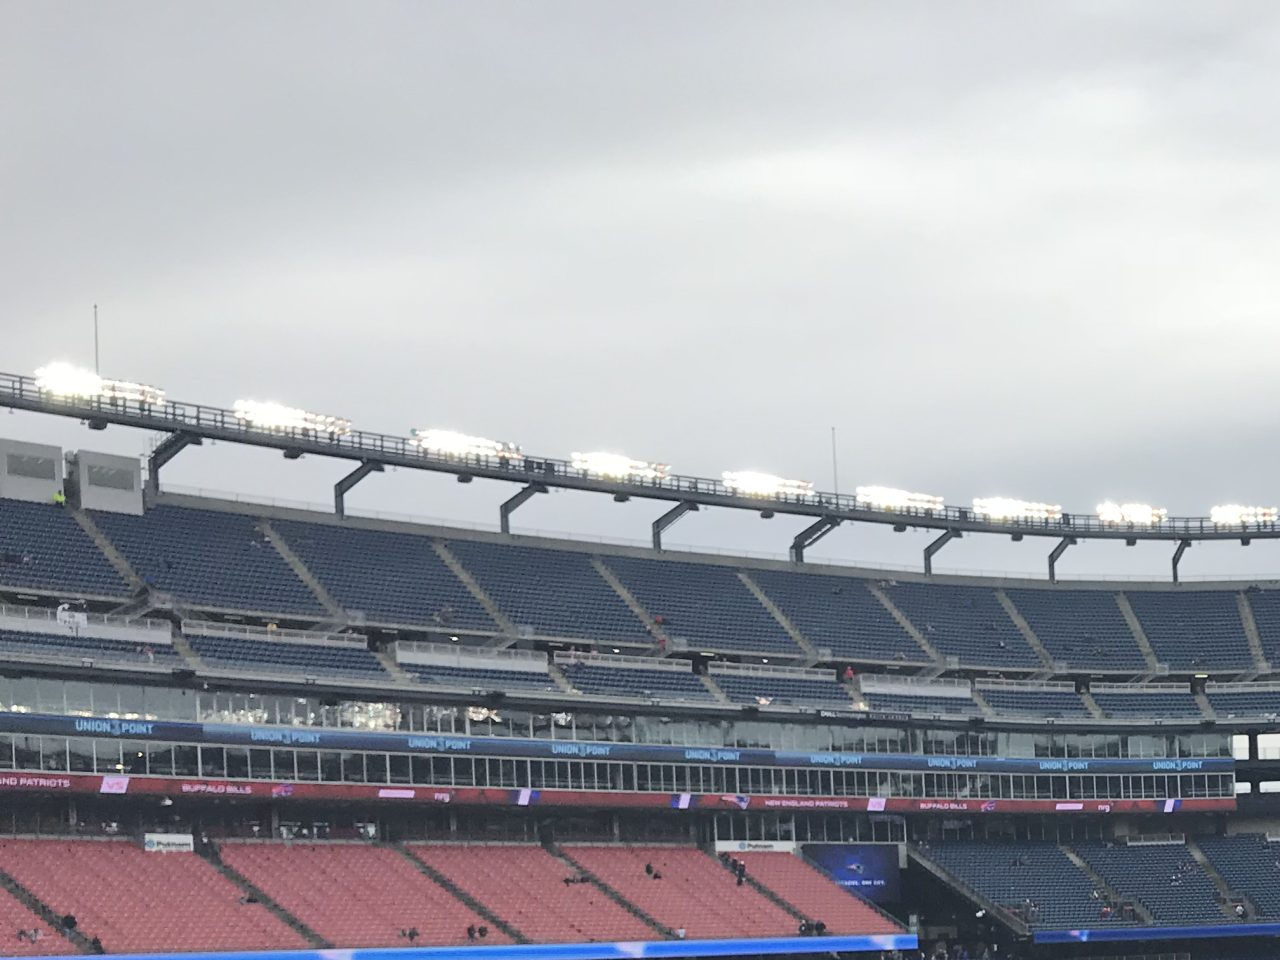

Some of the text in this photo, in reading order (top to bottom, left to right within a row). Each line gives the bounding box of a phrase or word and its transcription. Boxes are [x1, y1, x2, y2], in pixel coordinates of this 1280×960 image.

[75, 719, 154, 735] UNION POINT
[251, 729, 320, 744] UNION POINT
[408, 737, 471, 751] UNION POINT
[551, 743, 610, 757] UNION POINT
[685, 749, 740, 761] UNION POINT
[810, 755, 862, 765] UNION POINT
[928, 758, 976, 768] UNION POINT
[1039, 761, 1089, 770] UNION POINT
[1153, 761, 1203, 770] UNION POINT
[20, 777, 70, 788] PATRIOTS
[920, 802, 949, 810] BUFFALO
